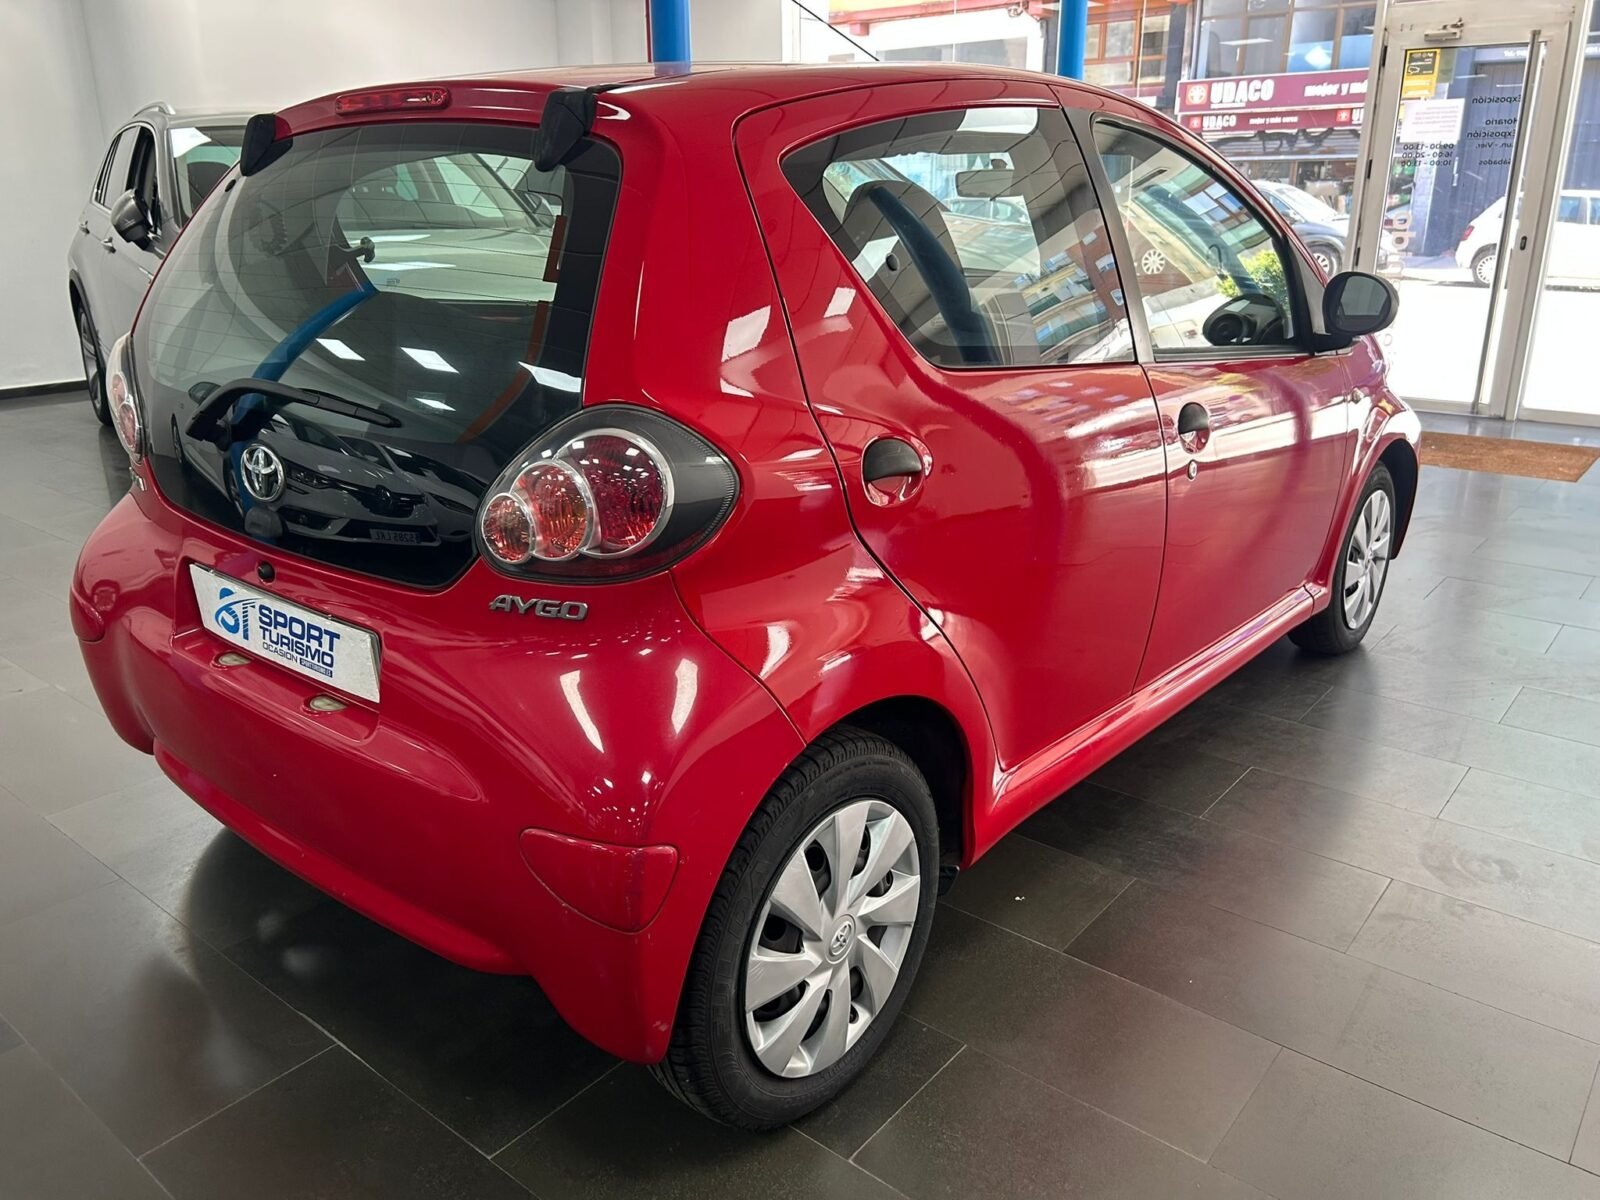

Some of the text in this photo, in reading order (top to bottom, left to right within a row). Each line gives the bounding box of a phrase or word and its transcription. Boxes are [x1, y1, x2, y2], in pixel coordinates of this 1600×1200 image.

[1210, 79, 1275, 103] UDACO
[1304, 79, 1368, 97] mejor y má
[1202, 114, 1237, 129] UDACO
[489, 594, 588, 621] AYGO
[258, 604, 341, 652] SPORT
[259, 625, 334, 668] TURISMO
[262, 641, 298, 663] OCASION
